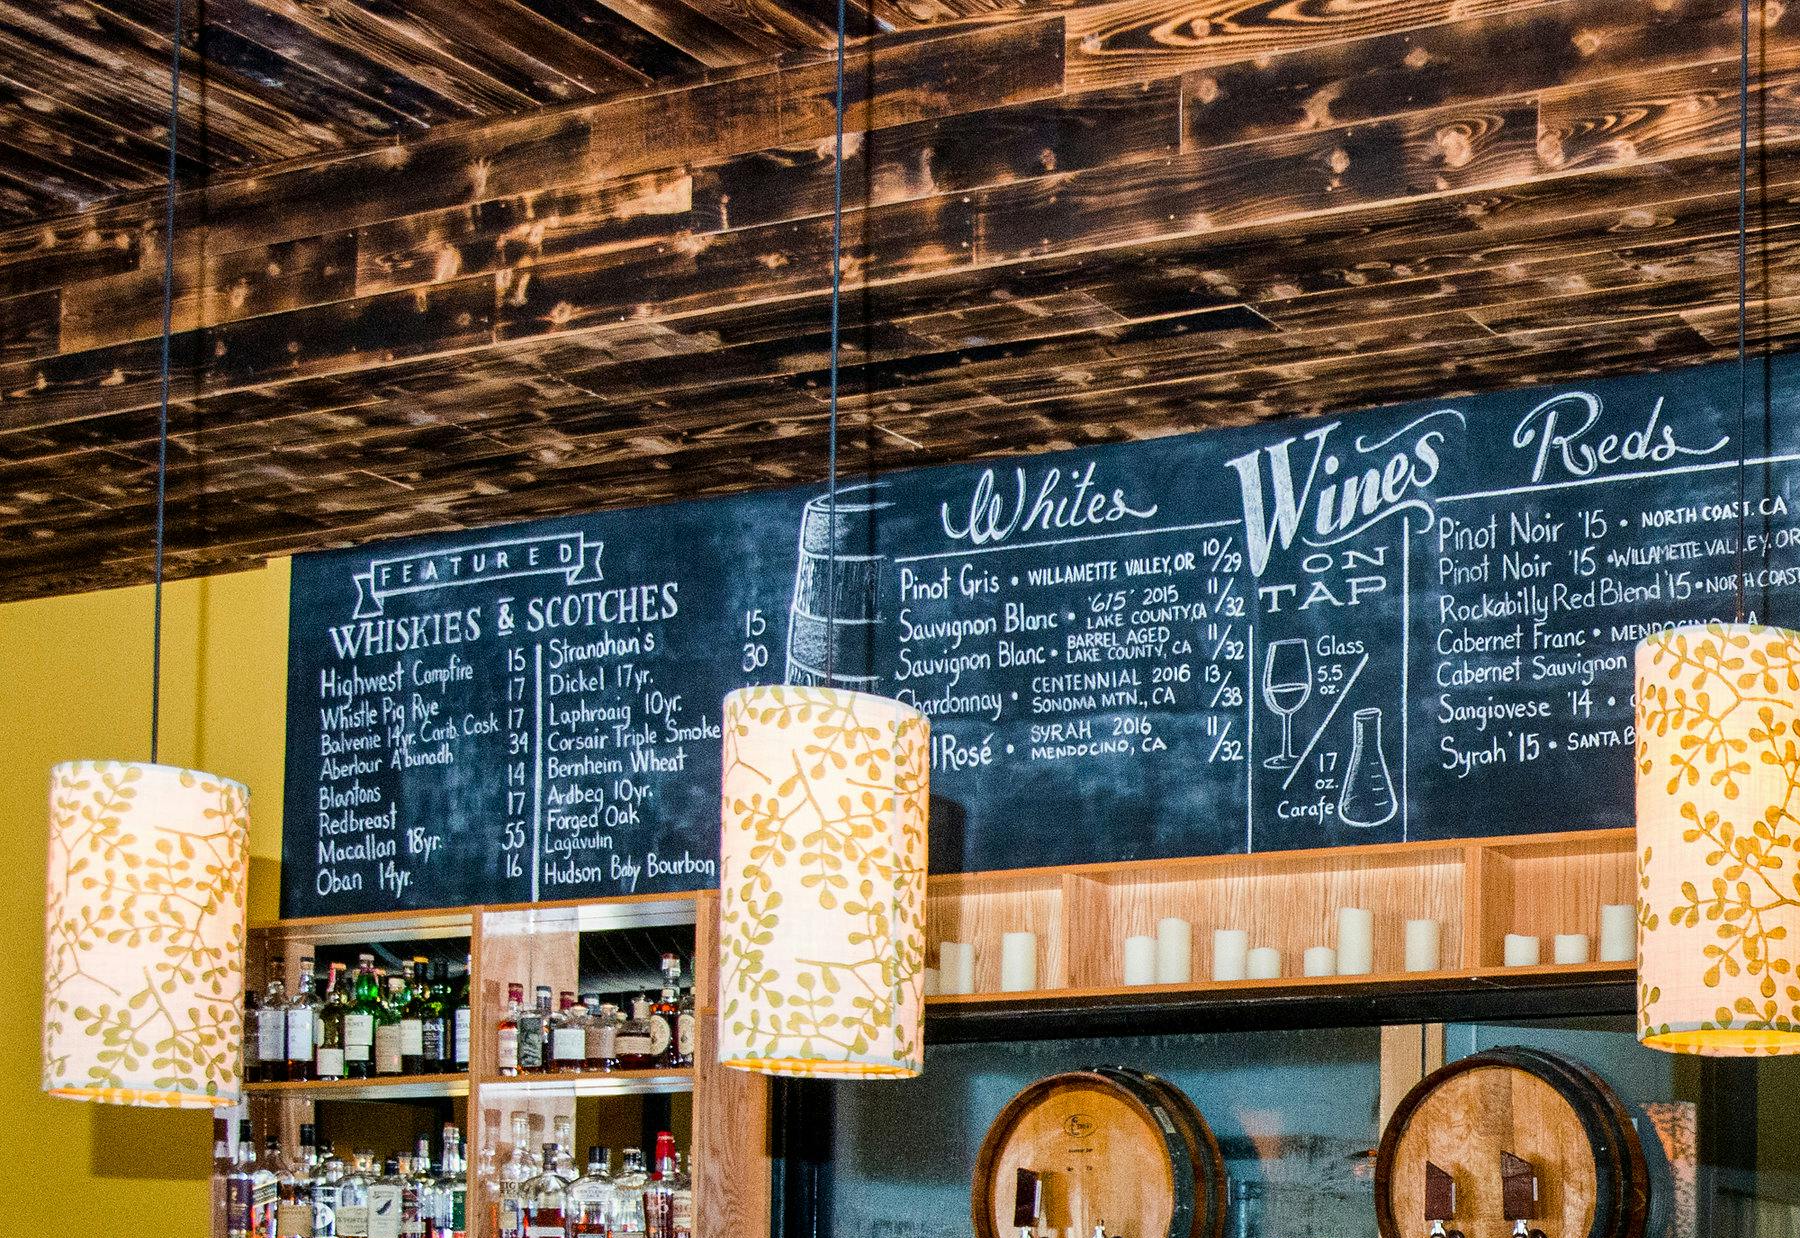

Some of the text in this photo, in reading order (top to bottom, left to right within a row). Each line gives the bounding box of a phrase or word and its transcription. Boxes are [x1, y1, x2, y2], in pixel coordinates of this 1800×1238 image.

[1514, 391, 1730, 483] Reds
[942, 462, 1157, 544] Whites
[1225, 420, 1445, 578] Wines
[1440, 513, 1563, 553] Pinot Noir
[380, 542, 572, 587] FEATURED
[1302, 546, 1389, 573] ON
[901, 561, 1117, 601] Pinot Gris WILLAMETTE
[1258, 577, 1386, 614] TAP
[1441, 574, 1661, 625] Rockabilly Red Blend
[330, 583, 678, 660] WHISKIES & SCOTCHES
[746, 609, 766, 637] 15
[900, 604, 1058, 648] Sauvignon Blanc
[1437, 625, 1585, 655] Cabernet Franc
[896, 627, 1170, 686] Sauvignon Blanc BARREL AGED
[1317, 636, 1364, 657] Glass
[321, 649, 525, 701] Highwest Campfire 15
[550, 669, 604, 697] Dickel
[743, 644, 768, 672] 30
[1032, 664, 1190, 694] CENTENNIAL 2016
[1317, 665, 1343, 683] 5.5
[1437, 653, 1627, 687] Cabernet Sauvignon
[321, 678, 524, 731] Whistle Pig Rye 17
[550, 698, 631, 727] Laphroaig
[1439, 695, 1551, 730] Sangiovese
[321, 735, 381, 756] Balvenie
[464, 714, 498, 735] Cask
[509, 707, 524, 730] 17
[548, 716, 721, 752] Corsair Triple Smoke
[1113, 717, 1151, 735] 2016
[319, 757, 383, 782] Aberlour
[549, 751, 687, 778] Bernheim Wheat
[1319, 753, 1338, 772] 17
[1441, 731, 1621, 778] Syrah SANTA
[319, 765, 524, 810] Blantons 14
[548, 786, 603, 812] Ardbeg
[319, 793, 525, 836] Redbreast 17
[548, 807, 640, 836] Forged Oak
[1278, 800, 1334, 825] Carafe
[319, 837, 395, 864] Macallan
[503, 822, 525, 849] 55
[545, 834, 612, 858] Lagavulin
[317, 870, 362, 897] Oban
[507, 856, 522, 878] 16
[545, 851, 715, 891] Hudson Baby Bourbon
